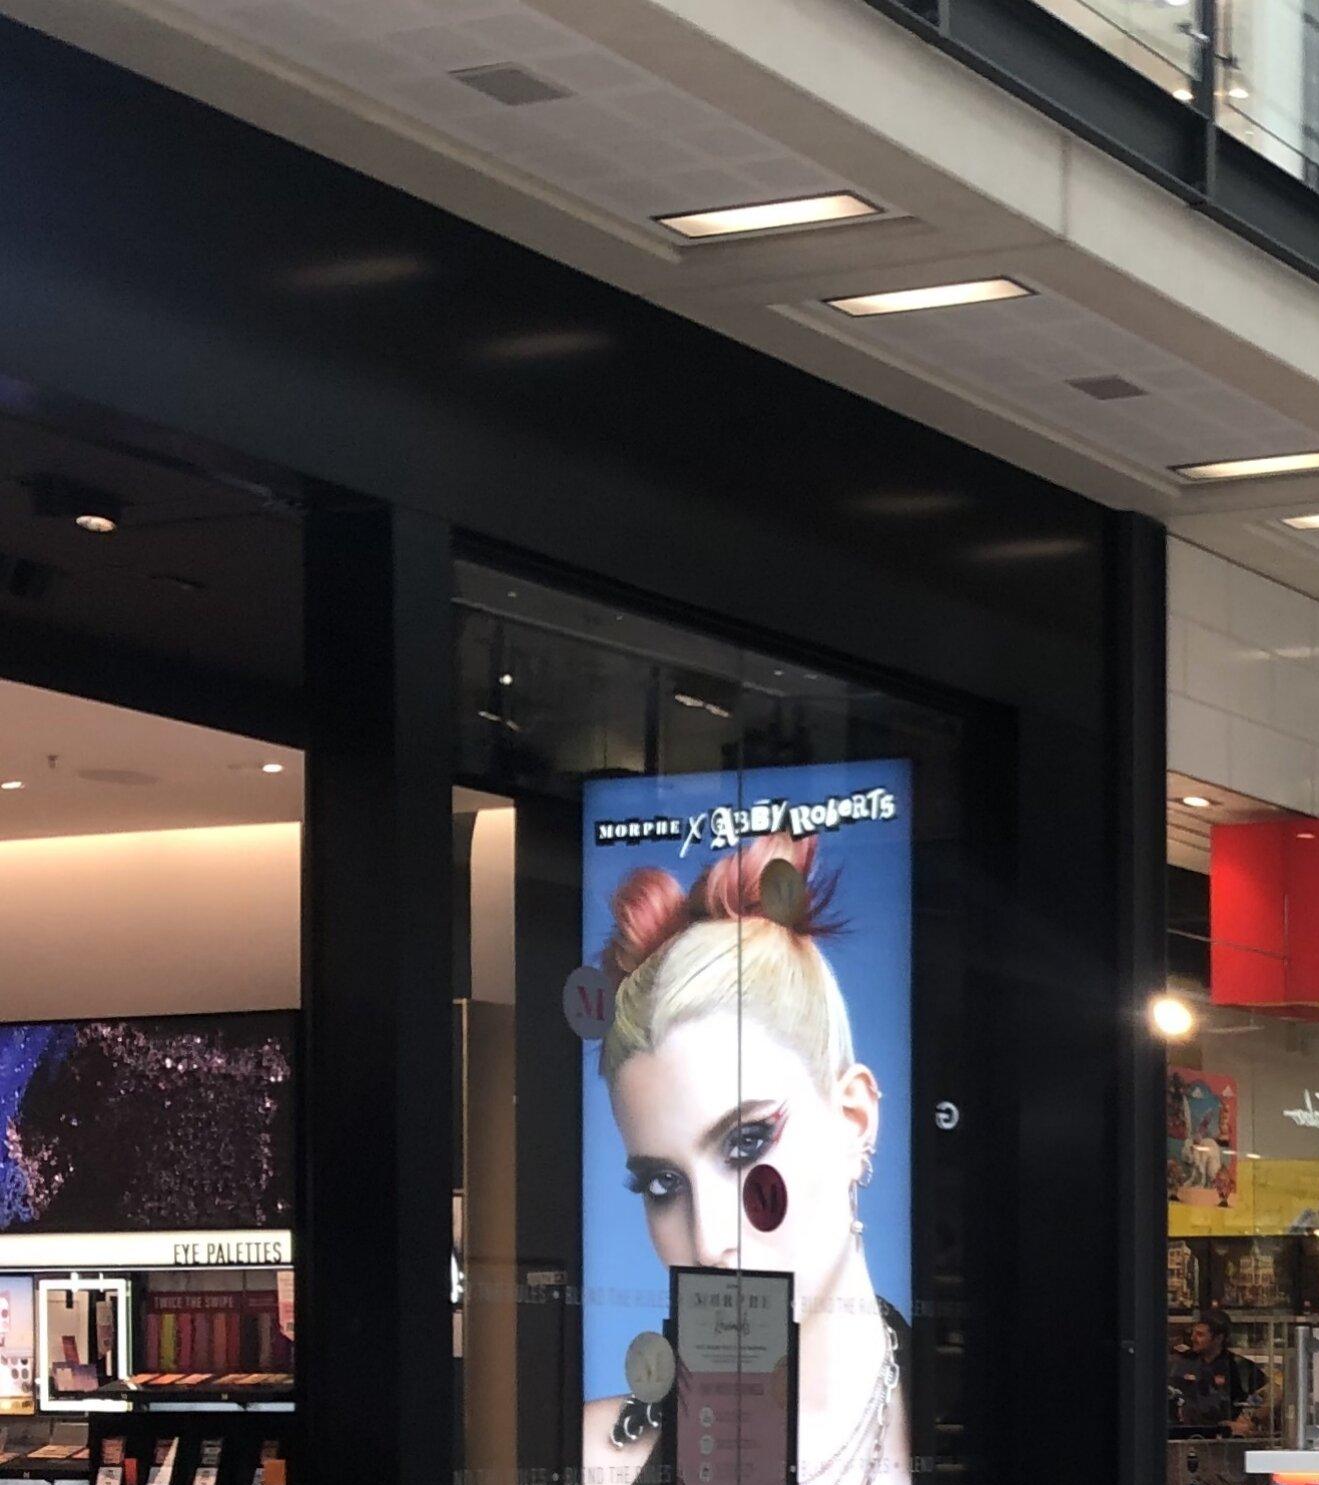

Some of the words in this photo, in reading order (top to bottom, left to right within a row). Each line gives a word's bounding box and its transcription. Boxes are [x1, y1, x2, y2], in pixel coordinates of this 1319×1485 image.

[598, 820, 680, 840] MORPHE
[174, 1243, 200, 1264] EYE
[207, 1242, 282, 1264] PALETTES
[185, 1296, 200, 1309] THE
